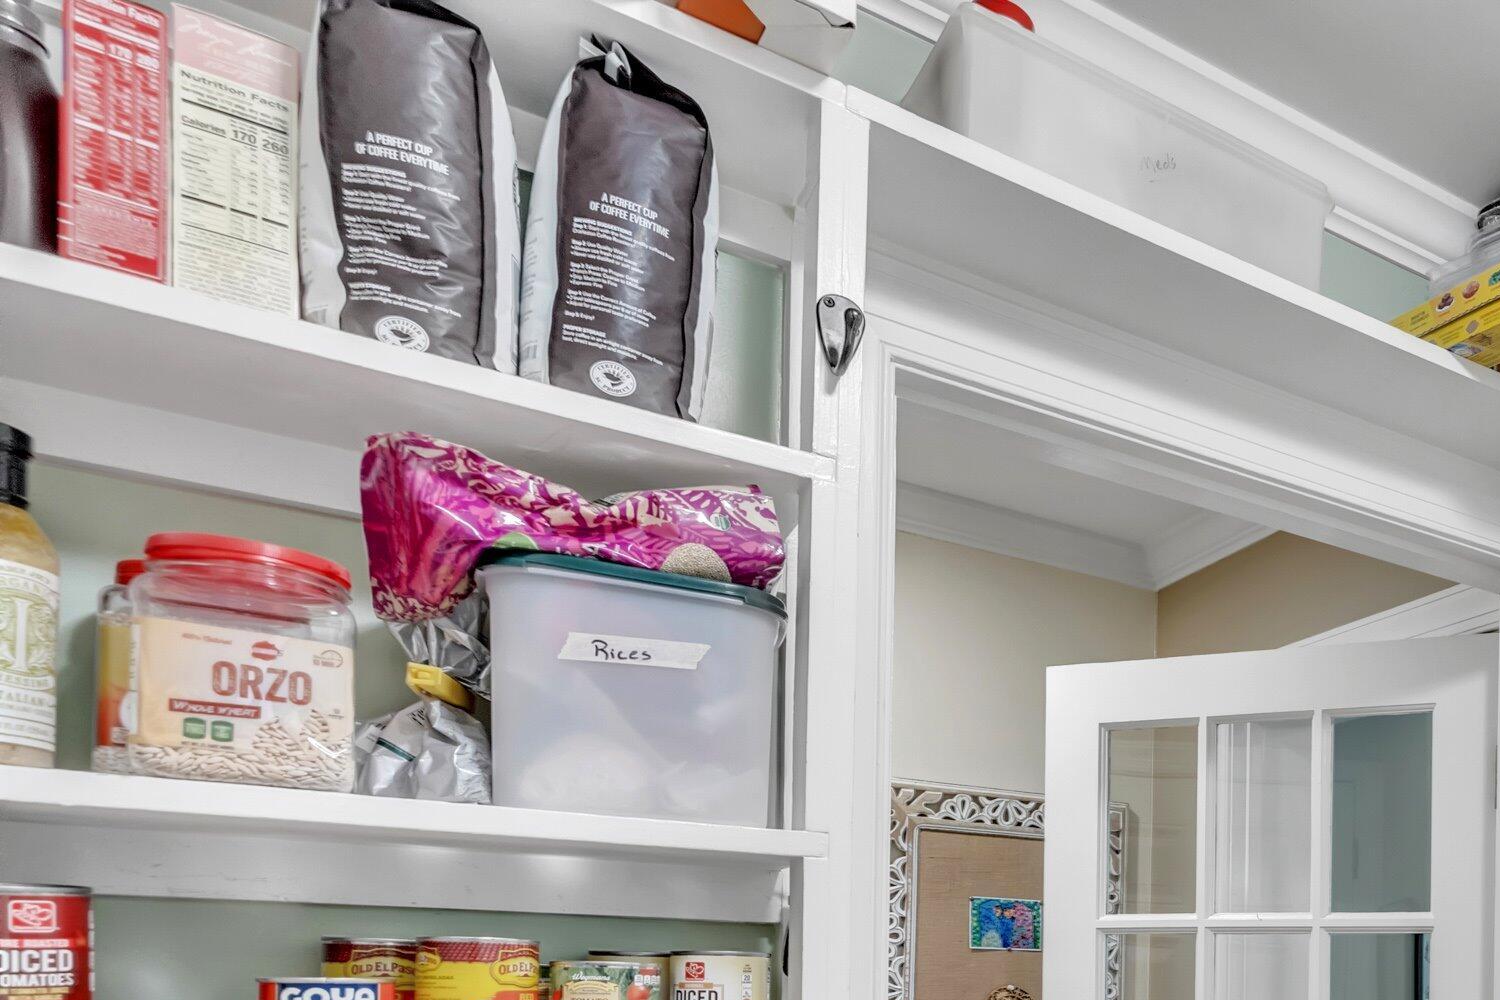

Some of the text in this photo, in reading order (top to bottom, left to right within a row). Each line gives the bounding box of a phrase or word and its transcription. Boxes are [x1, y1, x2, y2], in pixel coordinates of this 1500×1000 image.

[180, 70, 290, 114] Nutrition Facts
[180, 114, 227, 137] Calories
[231, 129, 290, 155] 170 260
[366, 130, 434, 157] A PERFECT CUP
[354, 142, 450, 176] OF COFFEE EVERYTIME
[601, 192, 658, 221] A PERFECT CUP
[589, 201, 670, 239] OF COFFEE EVERYTIME
[591, 639, 653, 663] Rices
[212, 660, 312, 706] ORZO
[172, 700, 259, 718] WHOLE WHEAT
[0, 973, 76, 988] OMATOES
[351, 961, 390, 975] OLD EL
